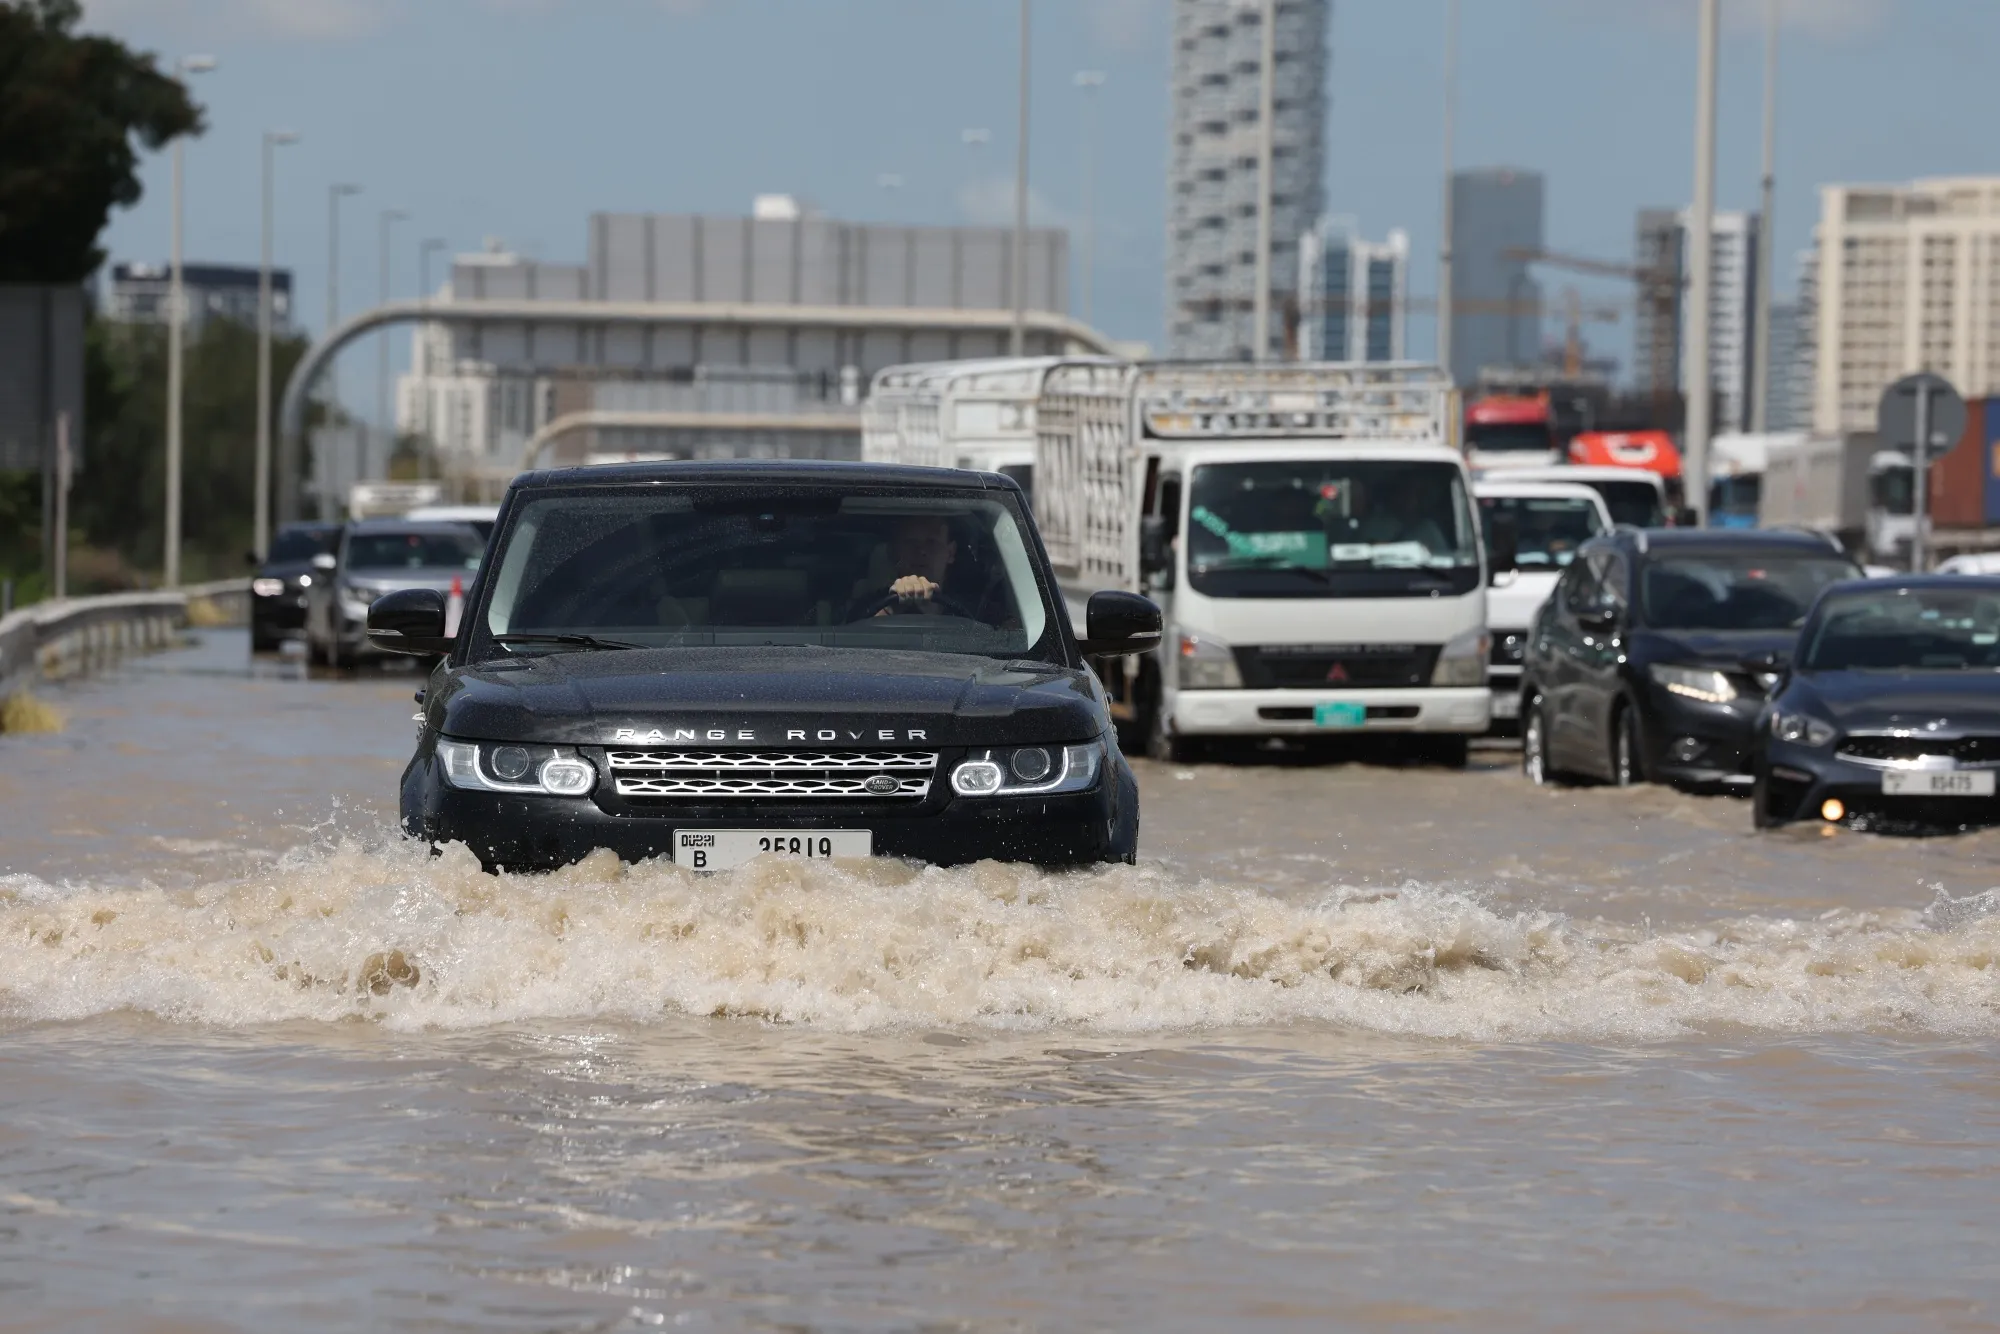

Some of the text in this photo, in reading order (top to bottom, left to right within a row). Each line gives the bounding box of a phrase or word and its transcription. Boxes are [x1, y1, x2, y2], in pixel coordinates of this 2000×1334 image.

[616, 728, 927, 741] RANGE ROVER
[693, 850, 707, 868] B
